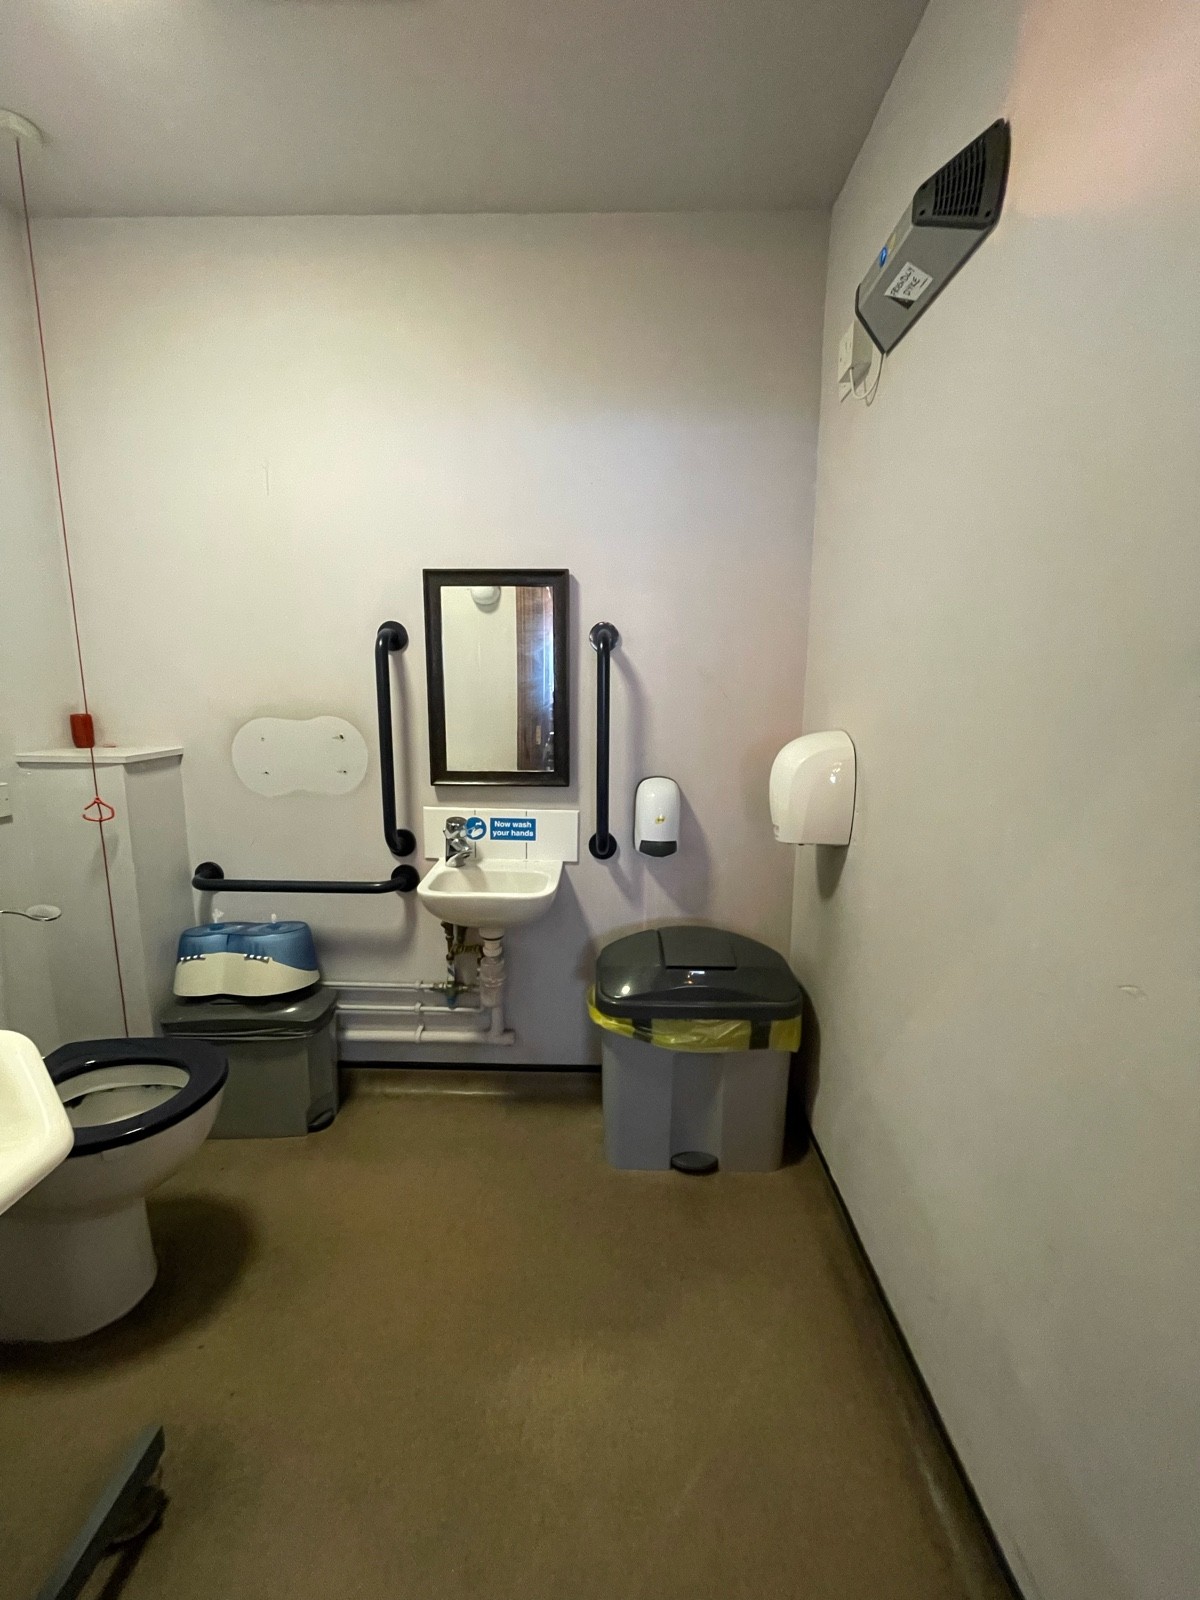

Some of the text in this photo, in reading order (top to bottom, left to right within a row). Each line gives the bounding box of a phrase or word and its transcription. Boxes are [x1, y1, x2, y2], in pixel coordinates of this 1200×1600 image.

[494, 820, 511, 828] Now
[492, 829, 534, 837] your hands
